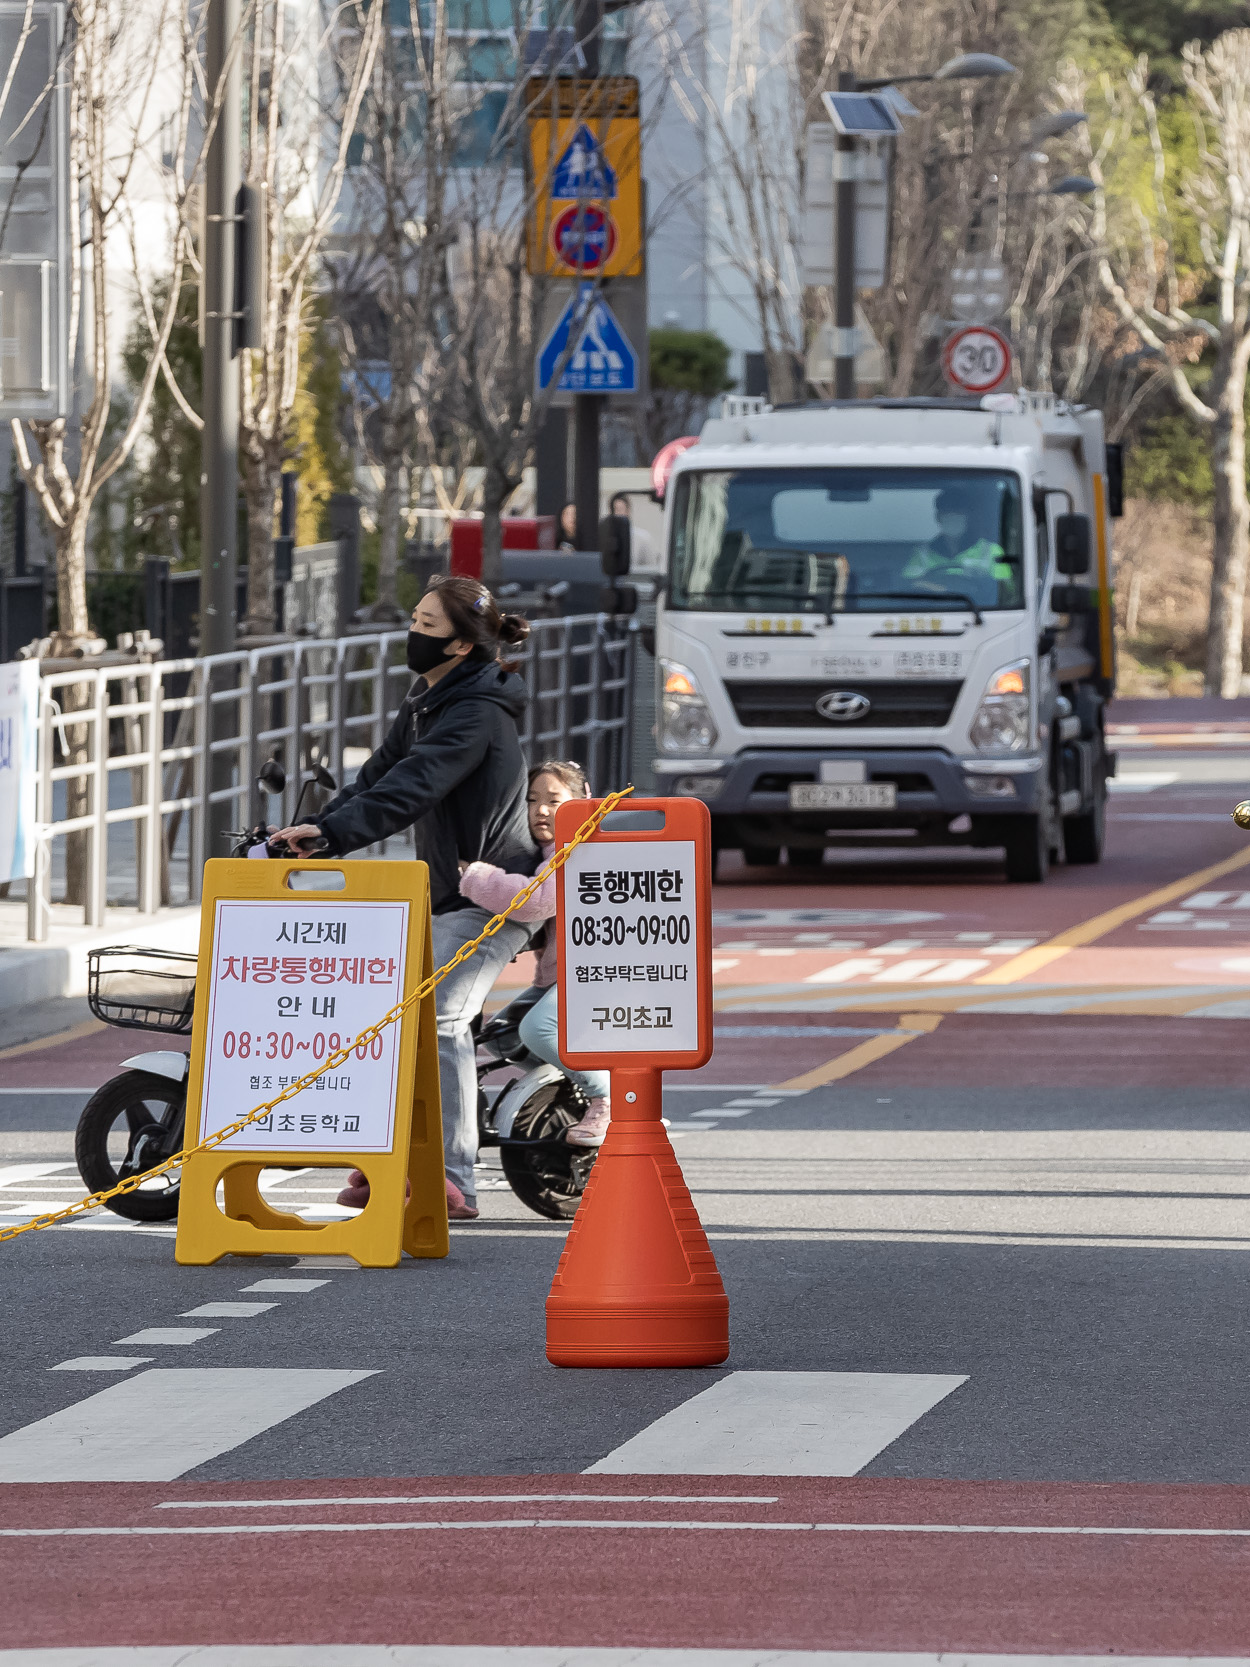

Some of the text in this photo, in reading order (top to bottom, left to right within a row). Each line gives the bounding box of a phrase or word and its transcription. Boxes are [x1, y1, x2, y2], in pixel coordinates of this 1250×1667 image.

[959, 344, 997, 375] 30
[577, 869, 683, 905] 통행제한
[275, 922, 347, 945] 시간제
[571, 914, 691, 946] 08:30~09:00
[220, 955, 397, 985] 차량통행제한
[575, 964, 688, 983] 협조부탁드립니다
[591, 1006, 673, 1031] 구의초교
[249, 1075, 273, 1090] 협조
[235, 1113, 361, 1134] 구의초등학교
